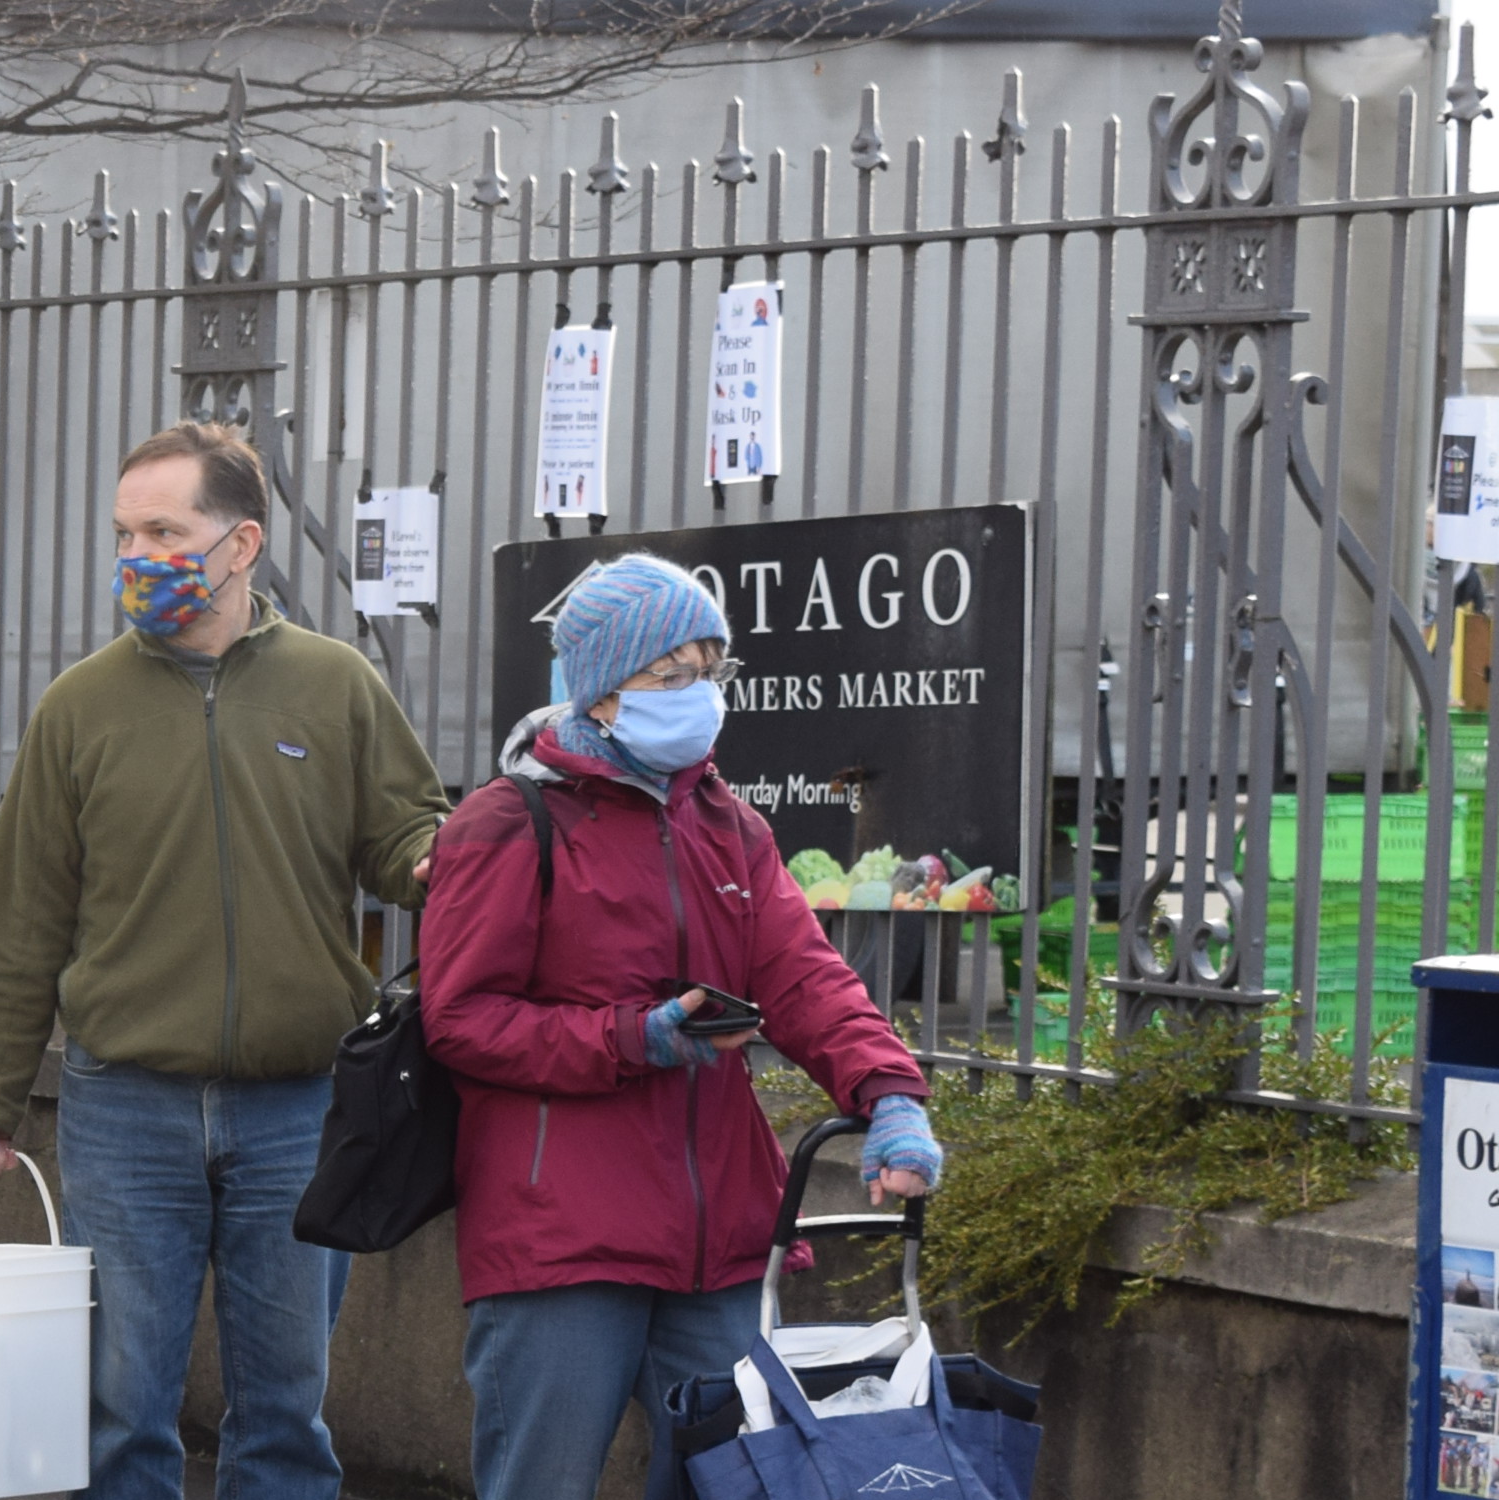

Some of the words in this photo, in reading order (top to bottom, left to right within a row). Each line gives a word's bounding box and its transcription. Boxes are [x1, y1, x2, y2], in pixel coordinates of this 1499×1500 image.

[718, 335, 752, 351] Please
[743, 359, 756, 374] In
[742, 406, 761, 425] Up
[838, 668, 985, 709] MARKET
[1457, 1127, 1499, 1172] Ot
